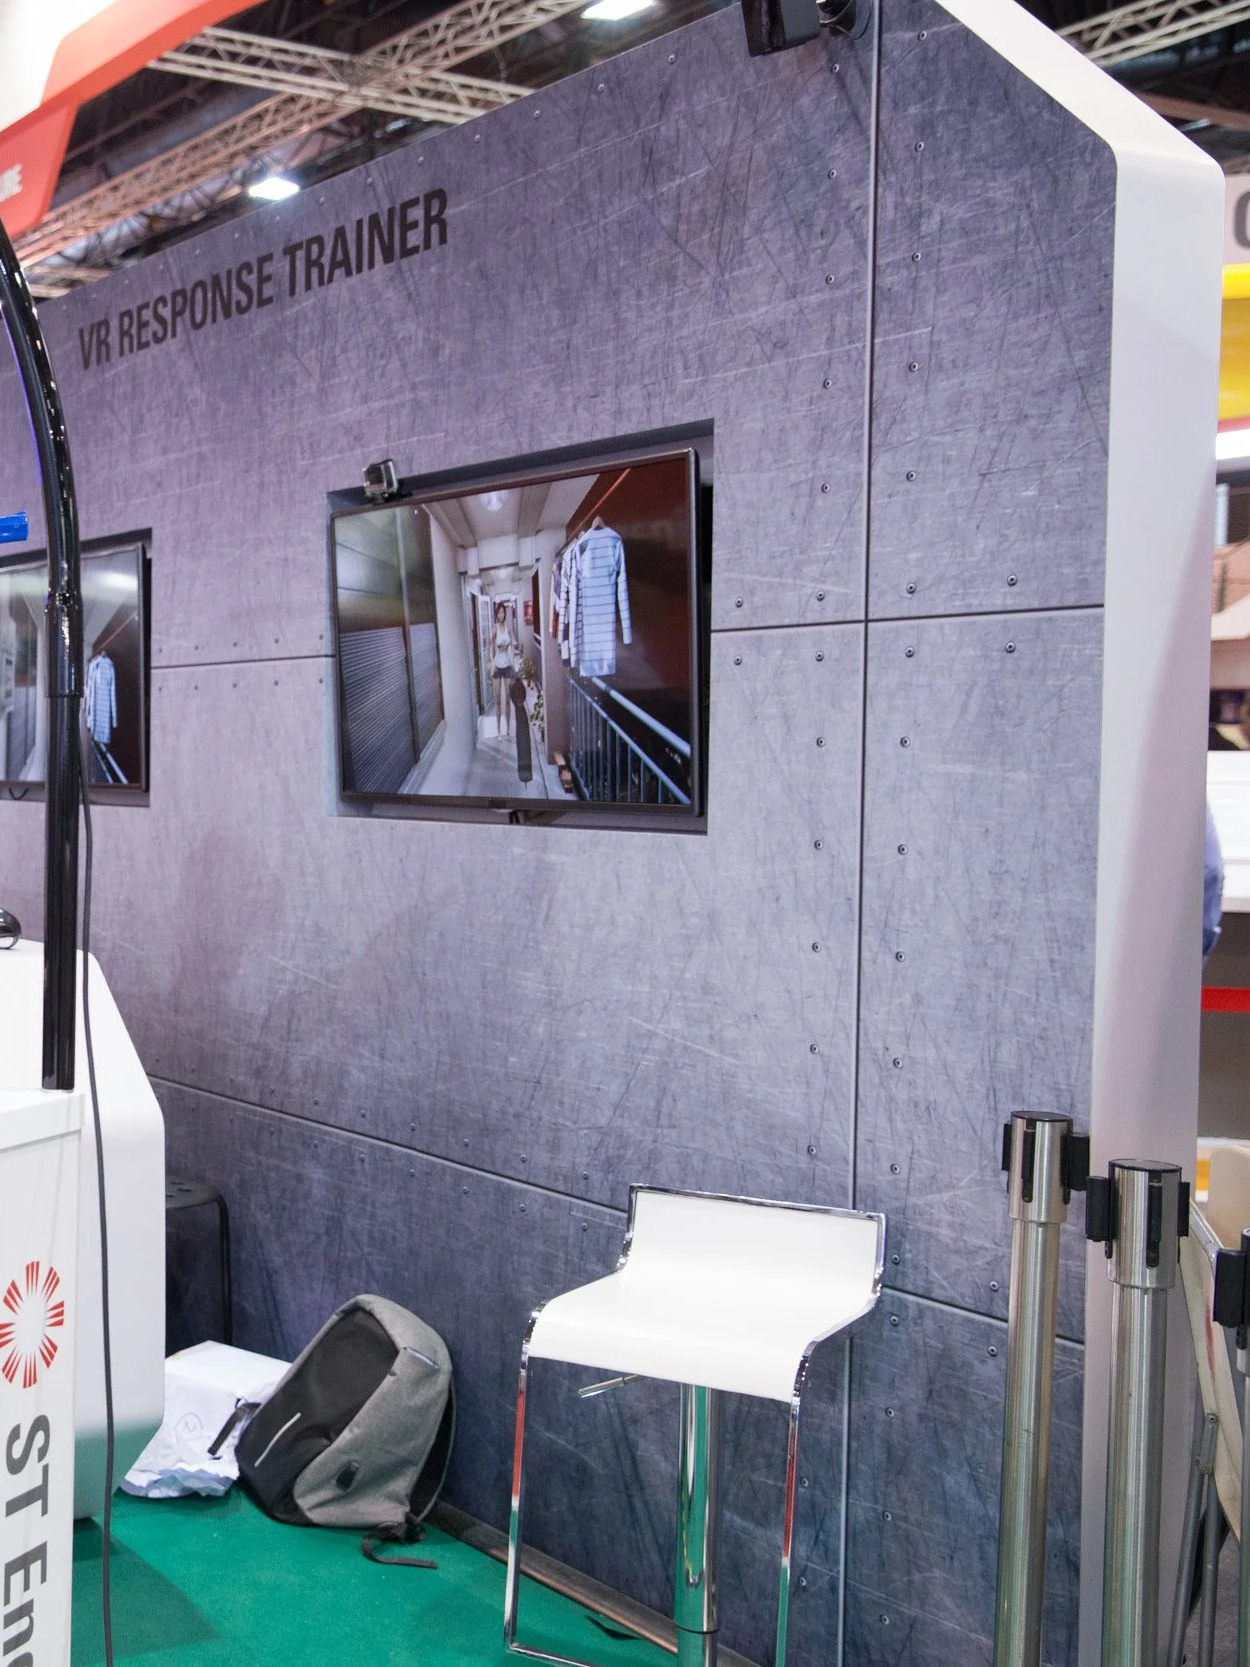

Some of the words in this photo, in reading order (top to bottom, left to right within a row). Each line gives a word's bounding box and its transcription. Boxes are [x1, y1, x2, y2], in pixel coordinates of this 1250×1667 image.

[79, 315, 111, 370] VR
[119, 254, 273, 357] RESPONSE
[283, 188, 448, 297] TRAINER
[5, 1413, 51, 1518] ST
